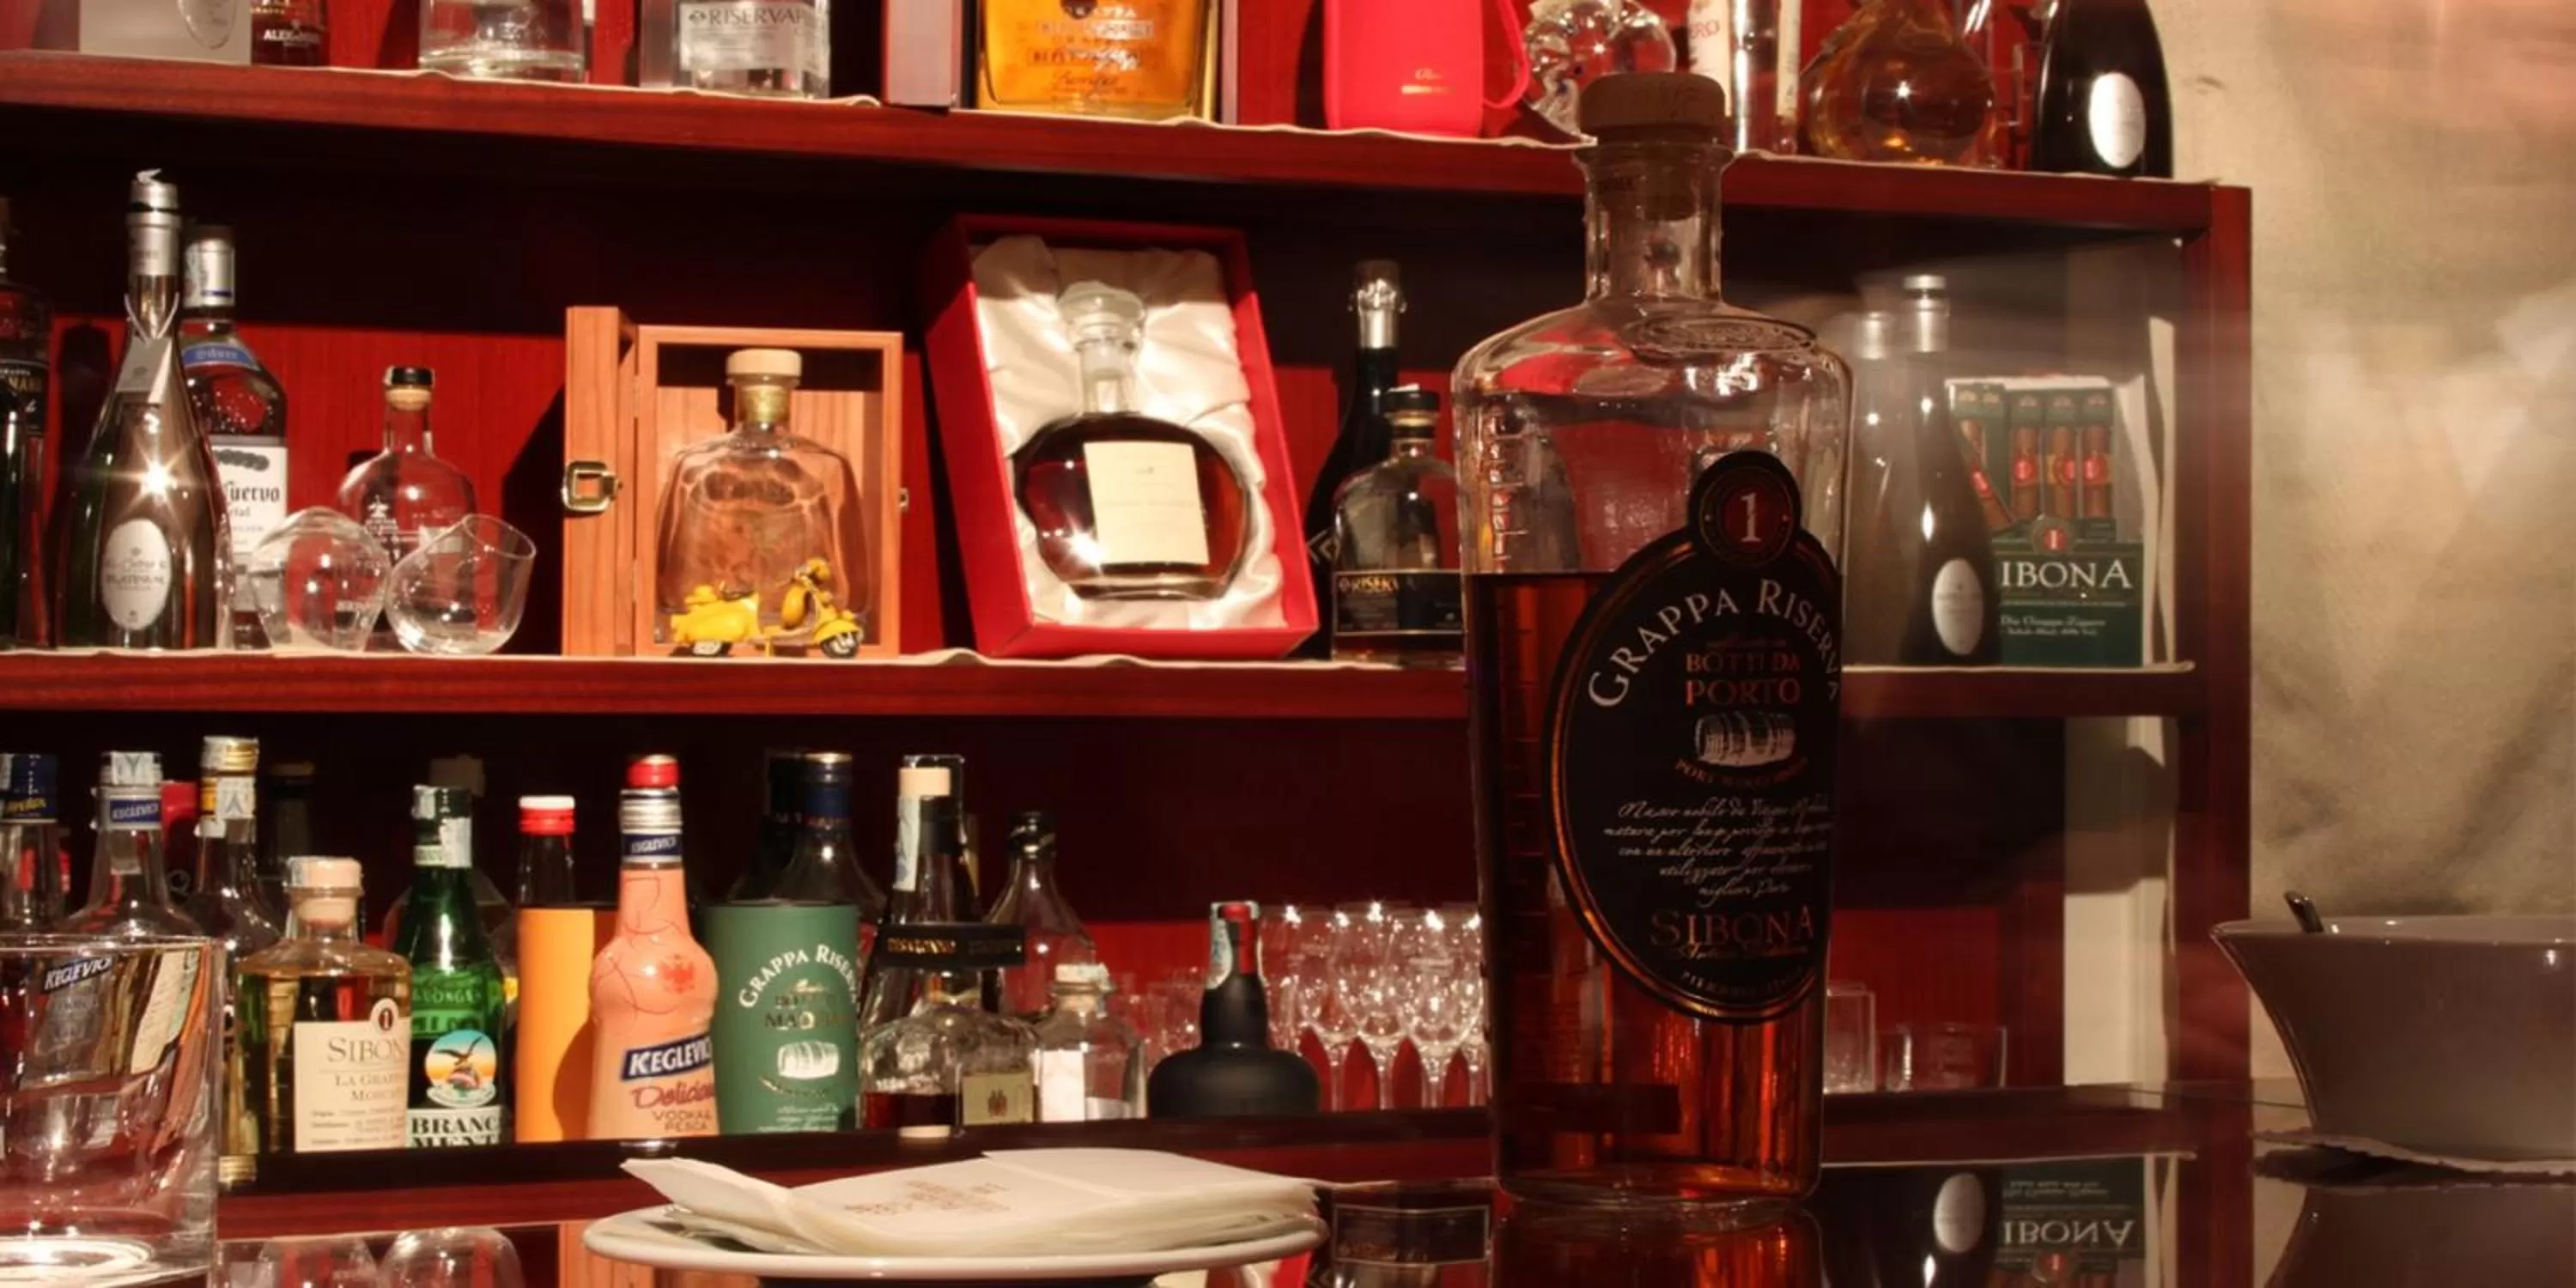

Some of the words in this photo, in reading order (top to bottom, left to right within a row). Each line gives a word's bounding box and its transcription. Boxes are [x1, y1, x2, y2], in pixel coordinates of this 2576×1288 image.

[1741, 490, 1764, 544] 1
[1587, 587, 1741, 708] GRAPPA
[1684, 677, 1801, 708] PORTO
[1650, 904, 1813, 946] SIBONA
[738, 948, 811, 1008] GRAPPA
